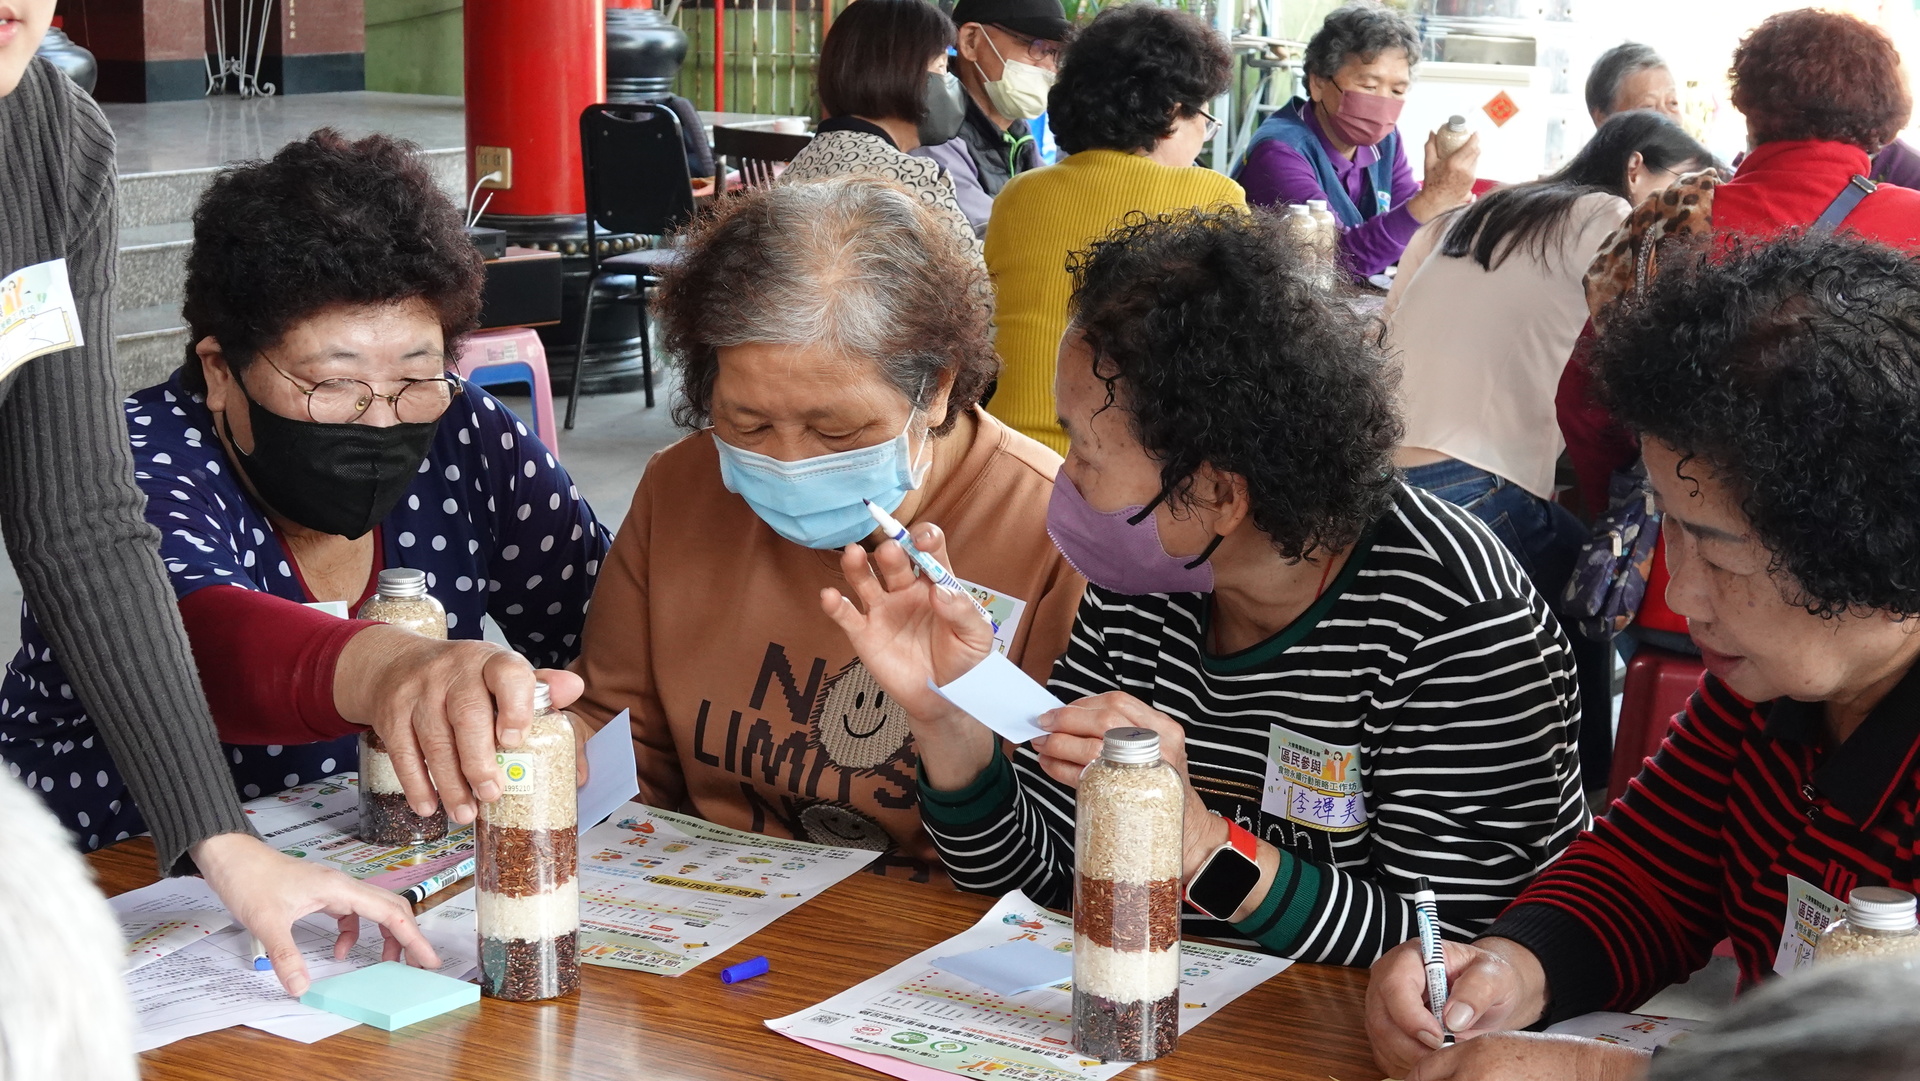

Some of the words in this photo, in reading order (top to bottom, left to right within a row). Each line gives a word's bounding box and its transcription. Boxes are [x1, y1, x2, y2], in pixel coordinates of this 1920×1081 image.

[1281, 748, 1321, 774] 區民參與
[1278, 766, 1358, 791] 食物永續行動策略工作坊
[1292, 789, 1361, 824] 李輝美
[1798, 900, 1830, 930] 區民參與
[612, 951, 681, 968] 區民參與
